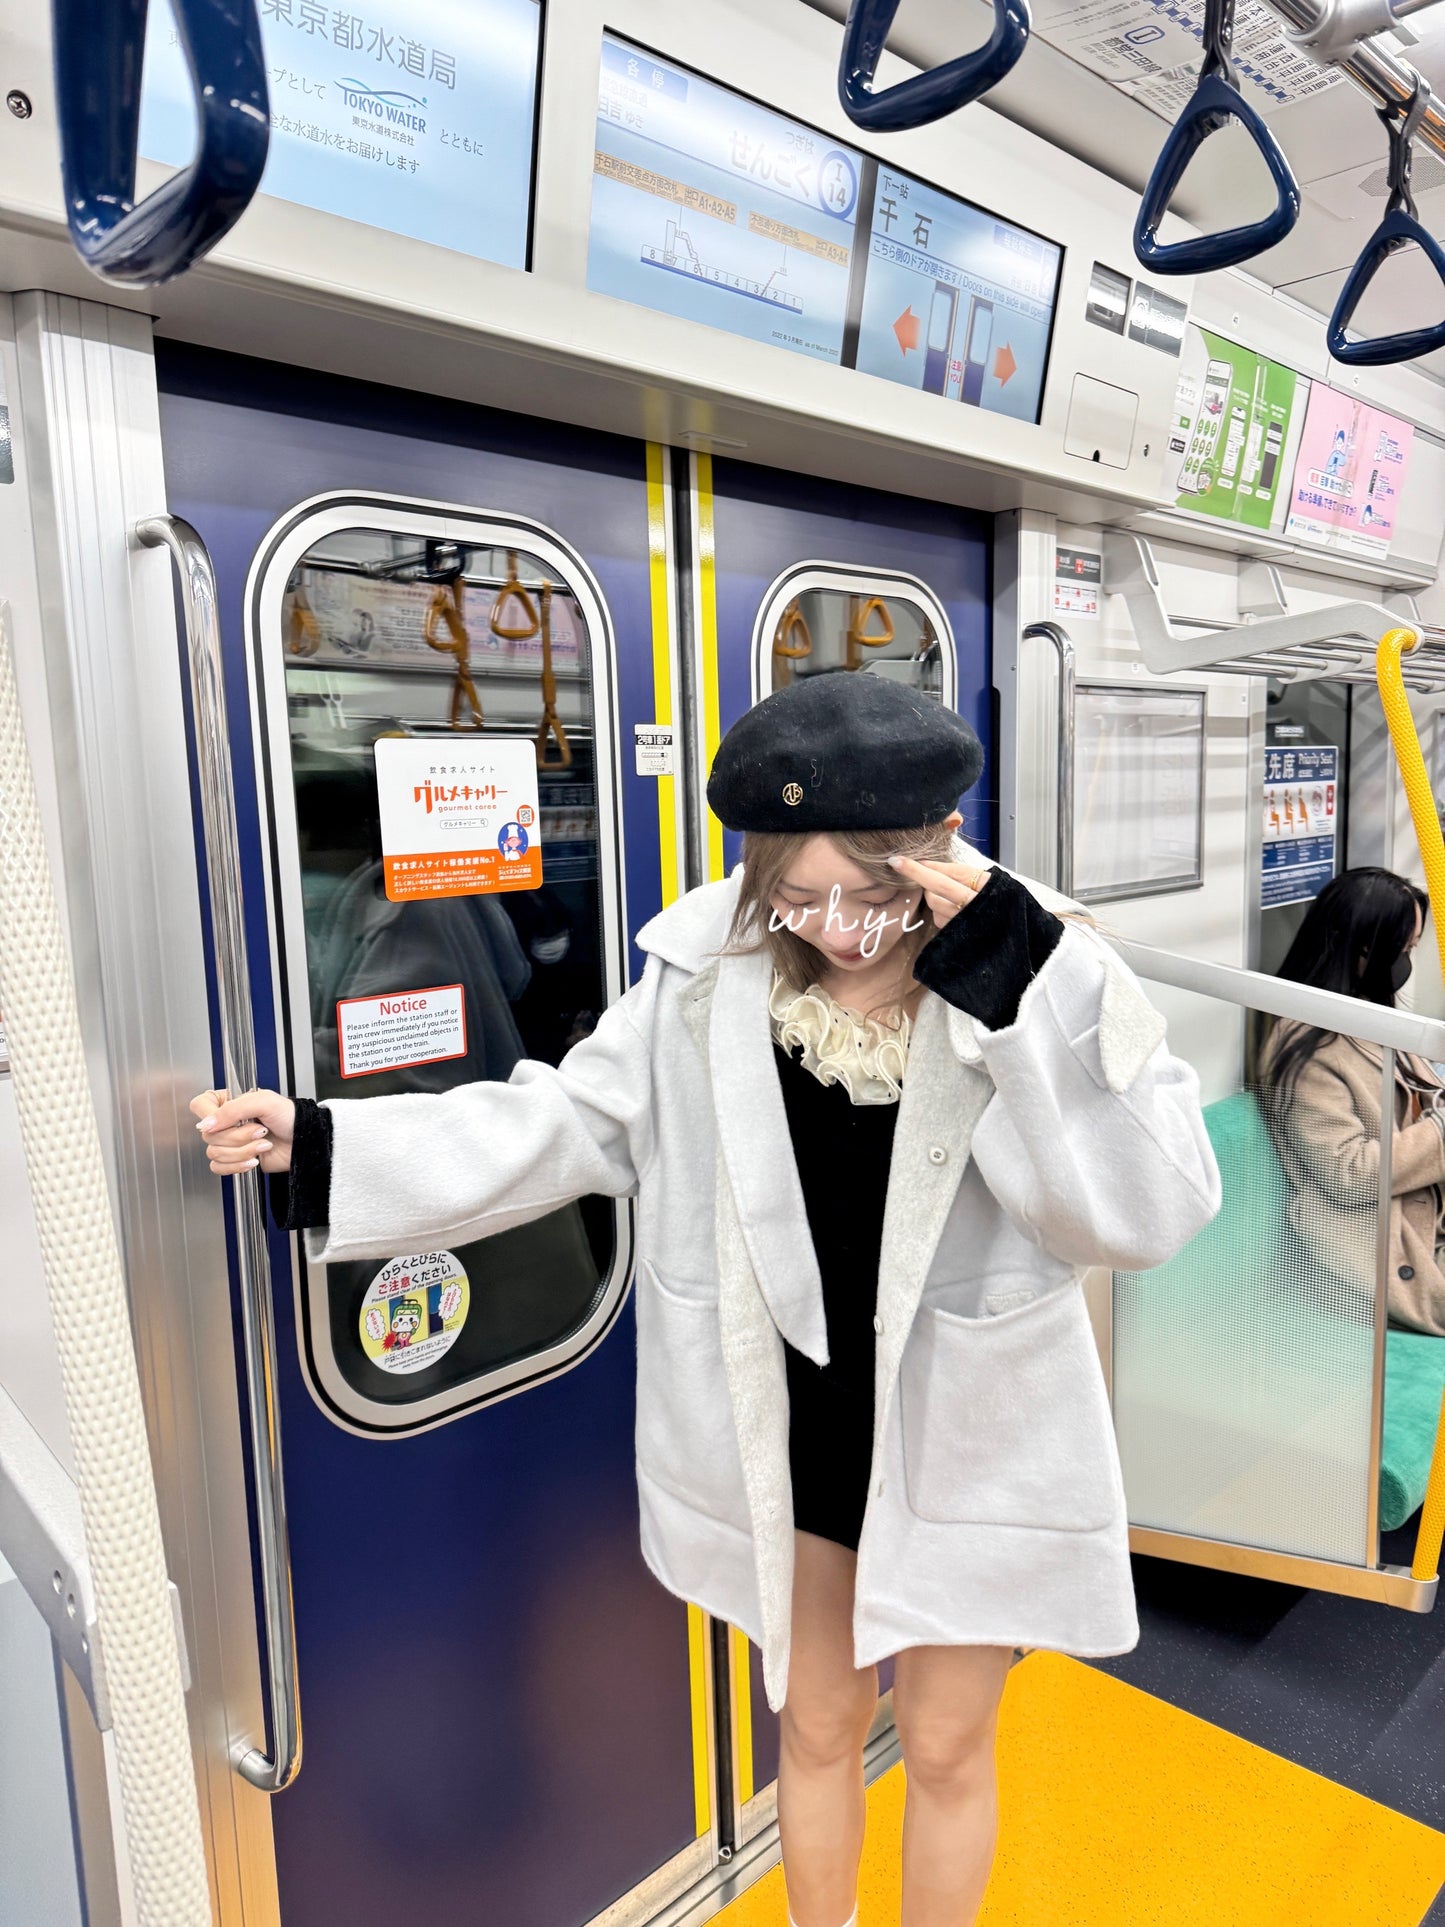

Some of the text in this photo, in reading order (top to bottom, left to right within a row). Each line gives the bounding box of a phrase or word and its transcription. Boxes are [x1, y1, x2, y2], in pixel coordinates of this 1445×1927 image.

[261, 0, 456, 90] 東京都水道局
[267, 67, 326, 100] プとして
[343, 89, 427, 134] TOKYO WATER
[352, 115, 415, 147] 東京水道株式会社
[440, 129, 484, 156] とともに
[785, 131, 815, 155] つぎは
[729, 131, 810, 198] せんごく
[830, 182, 846, 207] 14
[883, 174, 910, 200] 下一站
[429, 765, 496, 774] 飲食求人サイト
[1264, 753, 1295, 780] 先席
[413, 780, 508, 814] グルメキャリー
[438, 804, 472, 813] gourmet
[380, 998, 427, 1016] Notice
[346, 1023, 369, 1031] Please
[371, 1019, 395, 1028] inform
[409, 1013, 433, 1022] station
[434, 1009, 449, 1018] staff
[347, 1017, 458, 1041] train crew immediately if you notice
[348, 1051, 360, 1059] the
[361, 1047, 383, 1057] station
[402, 1041, 413, 1050] the
[413, 1040, 430, 1048] train.
[361, 1037, 395, 1049] suspicious
[396, 1030, 429, 1042] unclaimed
[430, 1027, 452, 1038] objects
[349, 1047, 448, 1070] Thank you for your cooperation.
[378, 1265, 451, 1295] ご注意ください
[382, 1253, 448, 1282] ひらくとびらに
[371, 1295, 387, 1304] Please
